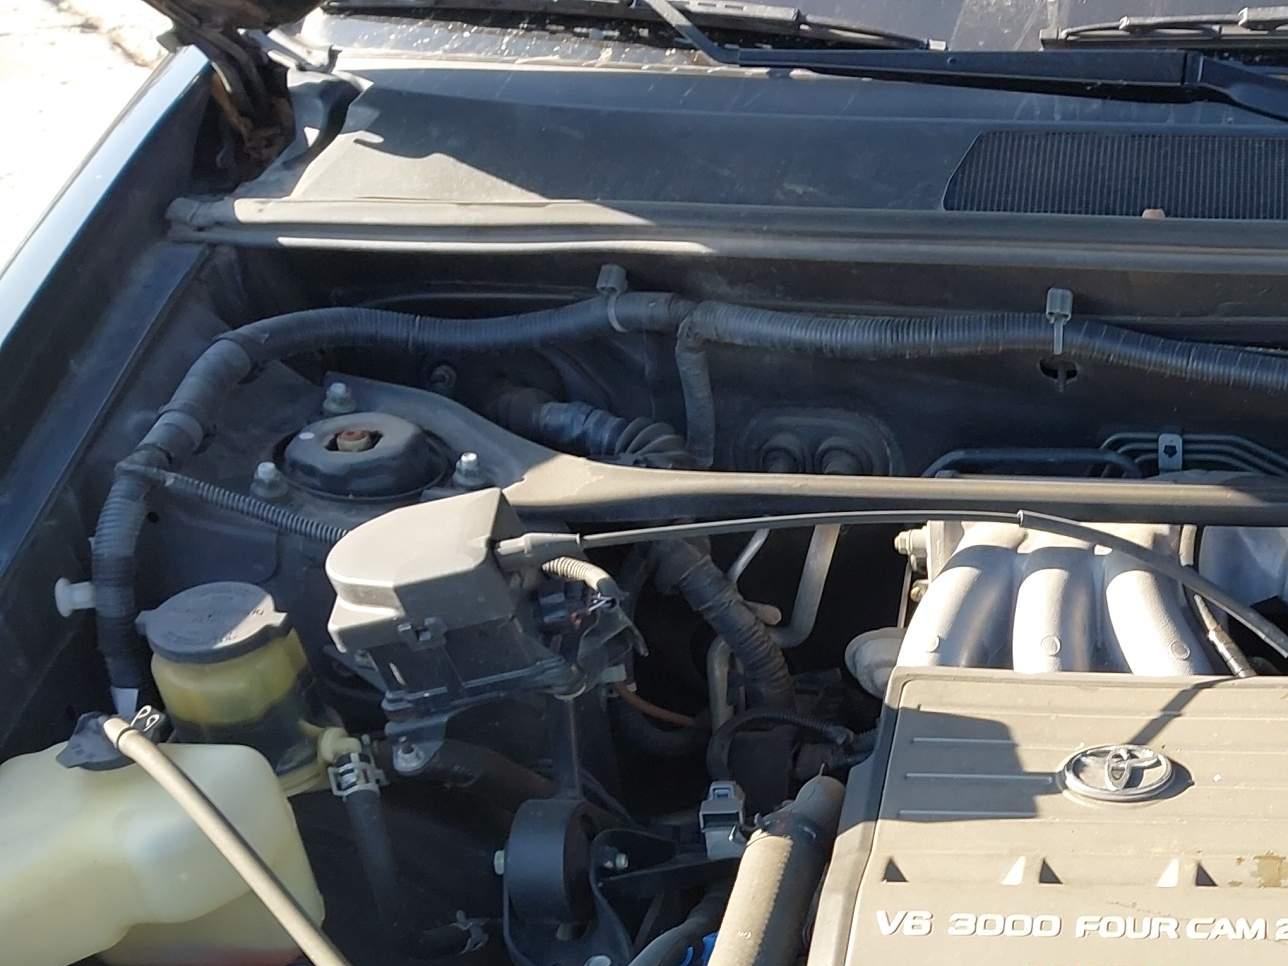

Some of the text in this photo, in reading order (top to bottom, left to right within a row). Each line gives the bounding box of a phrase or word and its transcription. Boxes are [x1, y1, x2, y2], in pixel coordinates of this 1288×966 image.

[876, 910, 933, 936] V6
[948, 913, 1062, 938] 3000
[1075, 915, 1179, 940] FOUR
[1186, 917, 1267, 941] CAM
